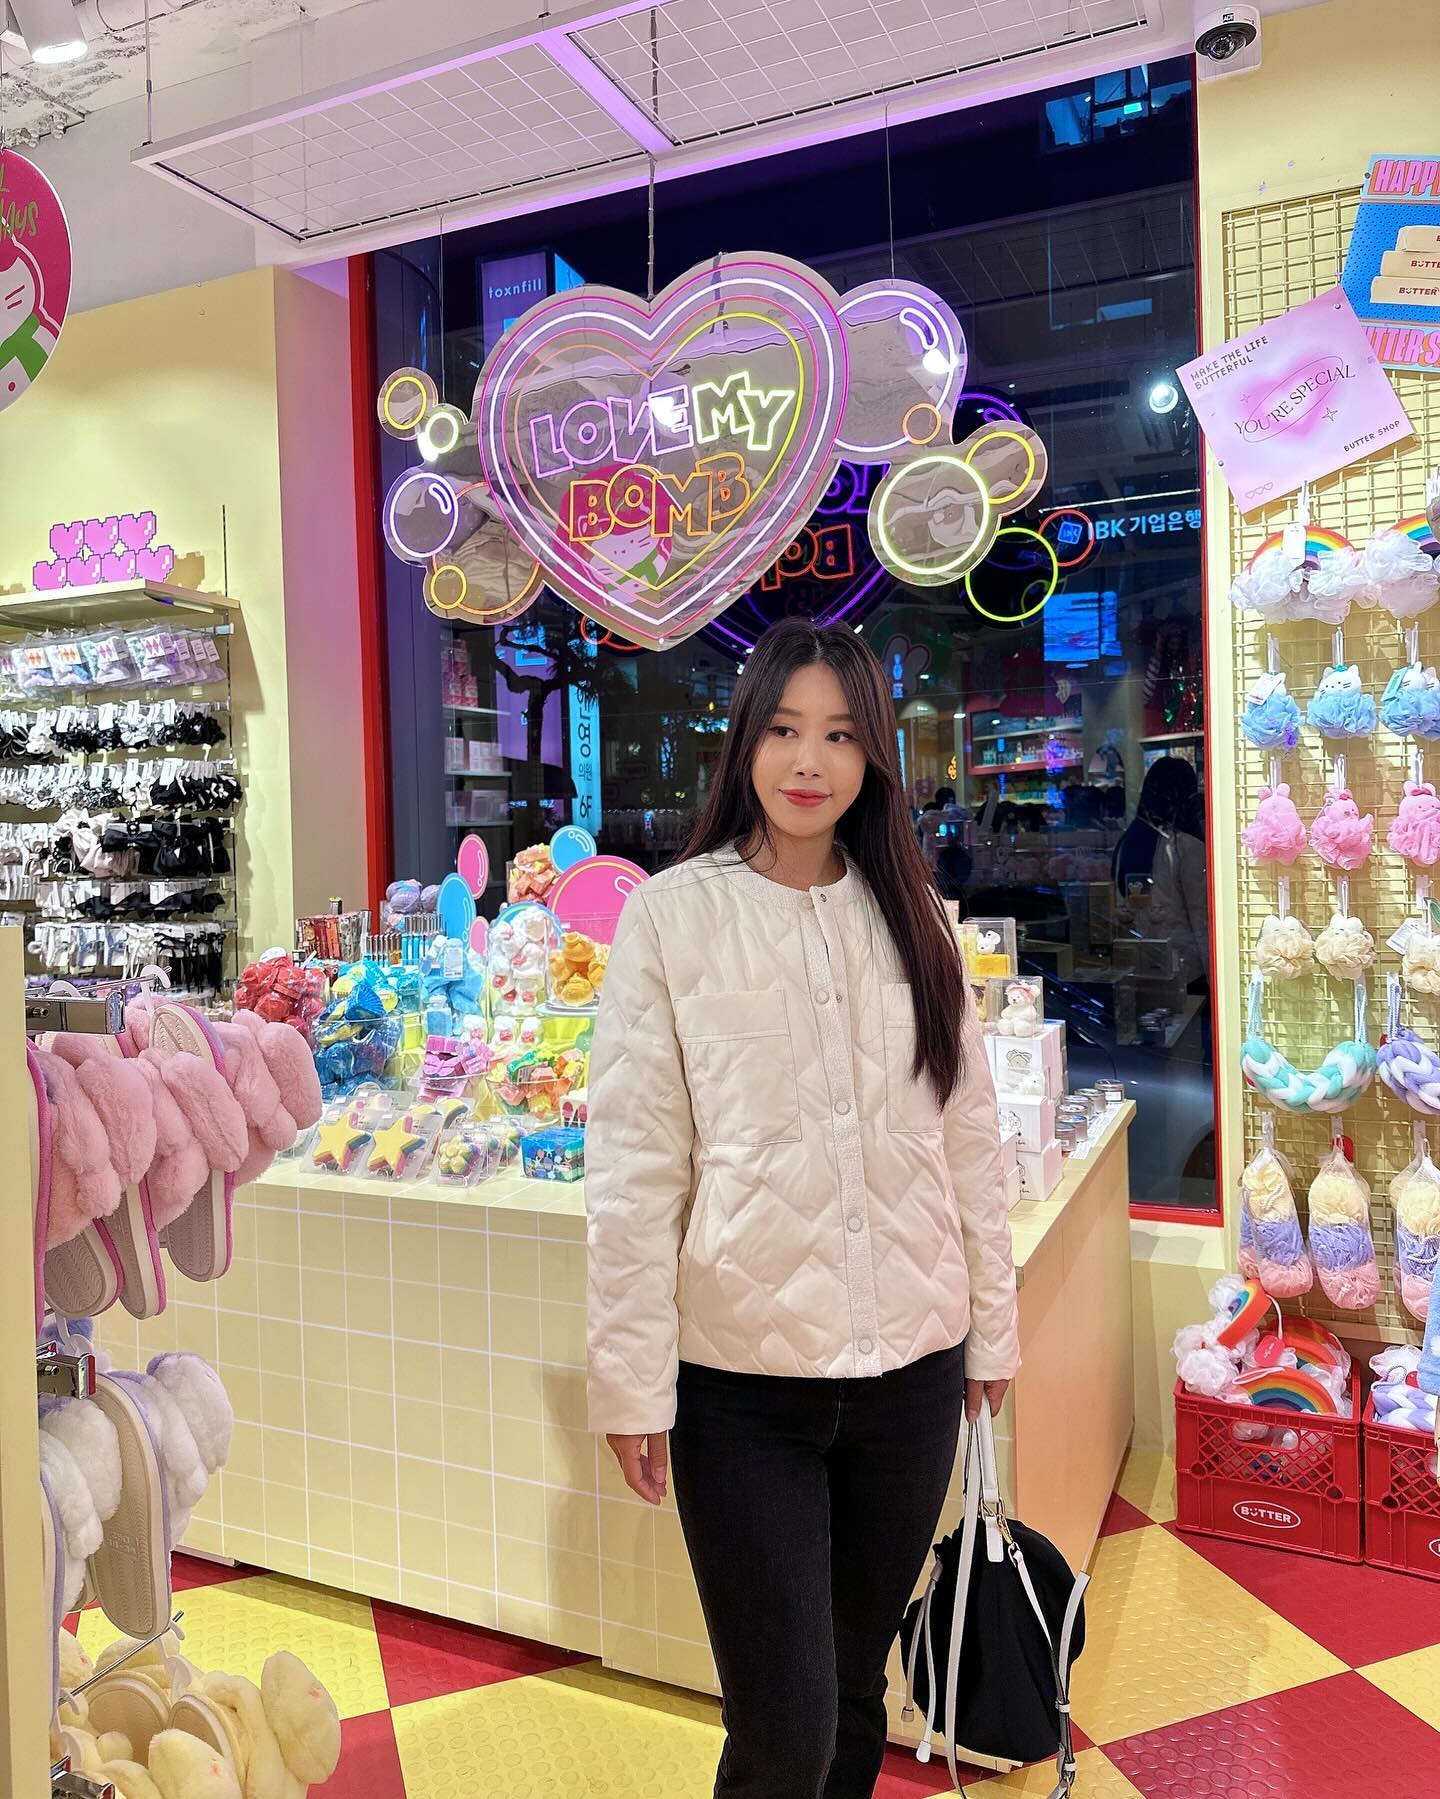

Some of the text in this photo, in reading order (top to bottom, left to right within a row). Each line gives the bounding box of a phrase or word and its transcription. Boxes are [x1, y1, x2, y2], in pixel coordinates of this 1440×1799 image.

[1368, 160, 1440, 195] HAPP
[488, 278, 542, 299] toxnfill
[1190, 335, 1269, 381] MAKE THE LIFE
[1194, 355, 1254, 390] BUTTERFUL
[1234, 364, 1356, 434] YOU'RE SPECIAL
[530, 371, 795, 478] LOVE MY
[1343, 420, 1400, 452] BUTTER SHOP
[569, 452, 750, 541] BOMB
[1087, 518, 1126, 540] IBK
[1129, 509, 1201, 534] 기업은행
